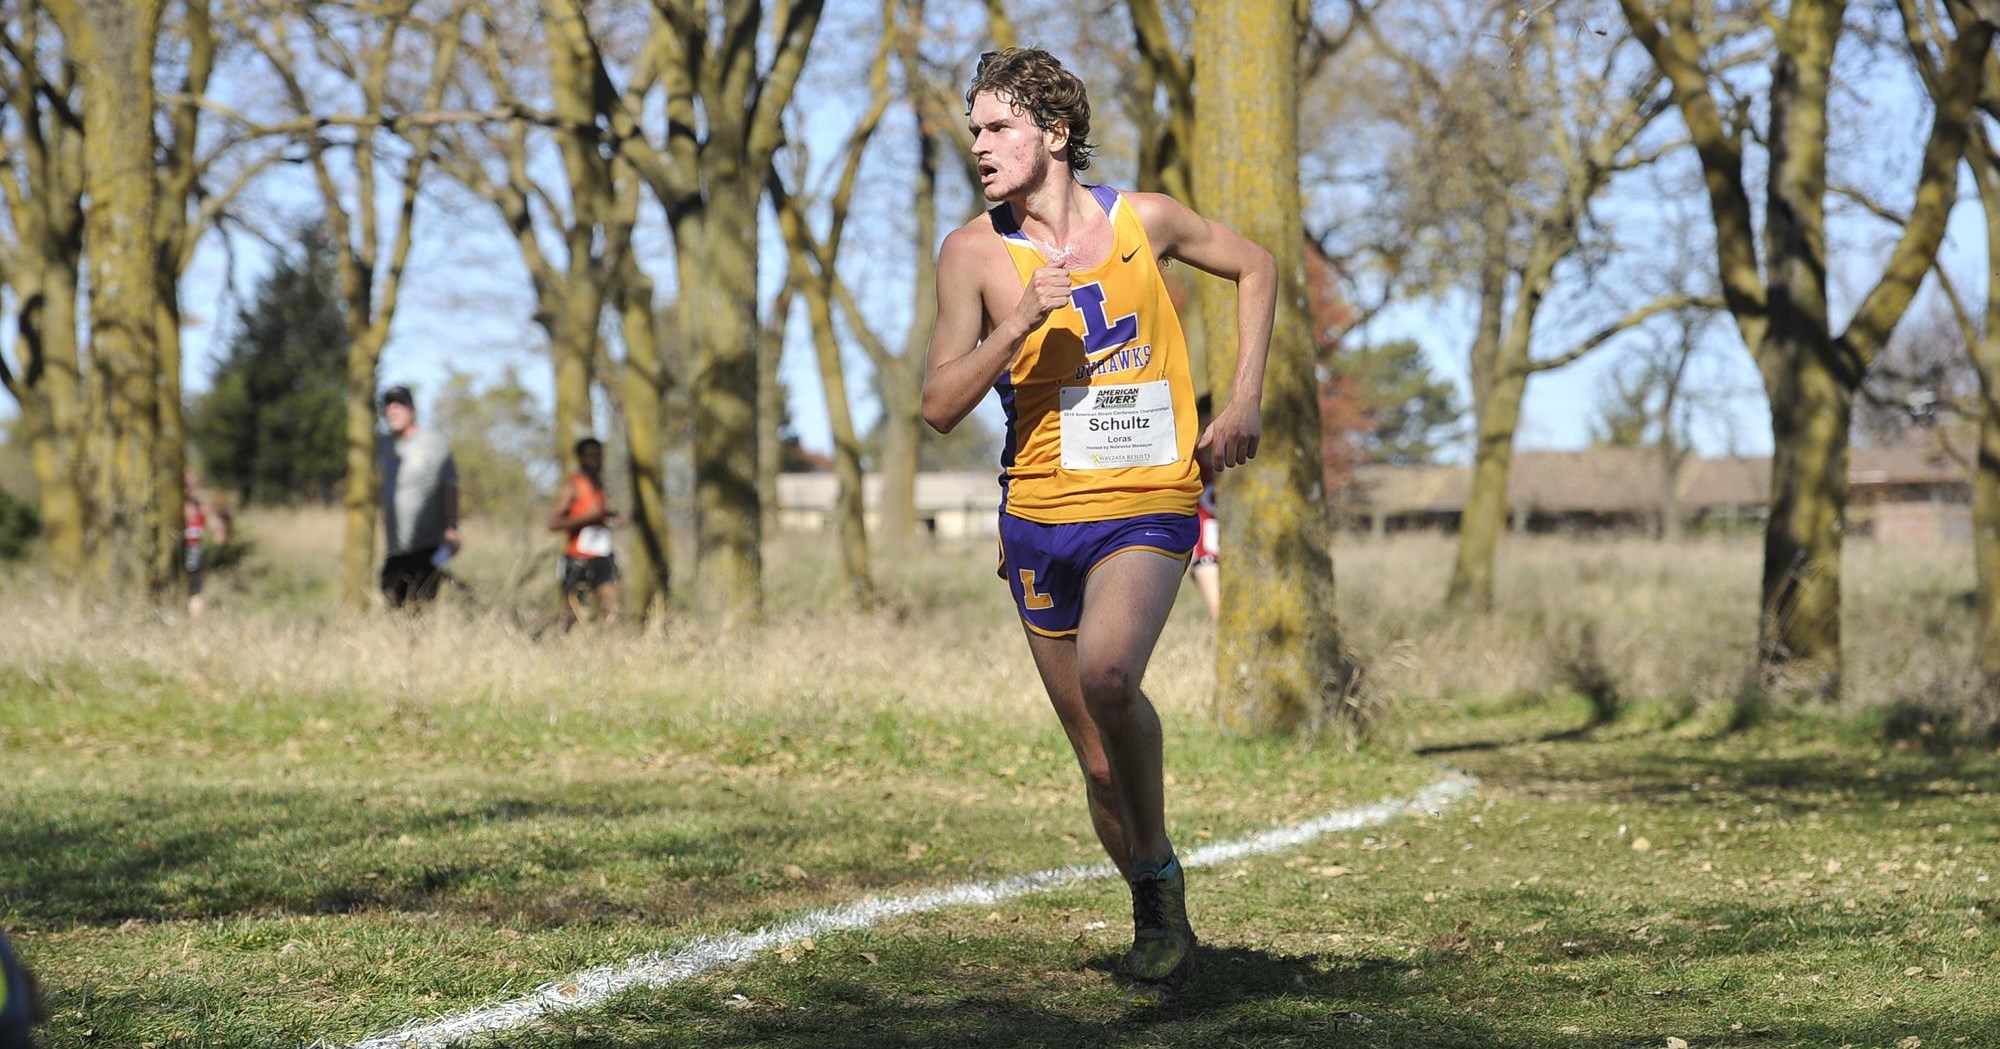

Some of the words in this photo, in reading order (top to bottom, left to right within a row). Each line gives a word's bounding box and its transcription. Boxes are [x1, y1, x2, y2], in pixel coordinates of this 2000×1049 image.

[1069, 280, 1139, 357] L
[1075, 344, 1152, 380] DUHAWKS
[1097, 388, 1139, 396] AMERICAN
[1089, 416, 1150, 432] Schultz
[1107, 435, 1132, 443] Loras
[1019, 568, 1055, 611] L
